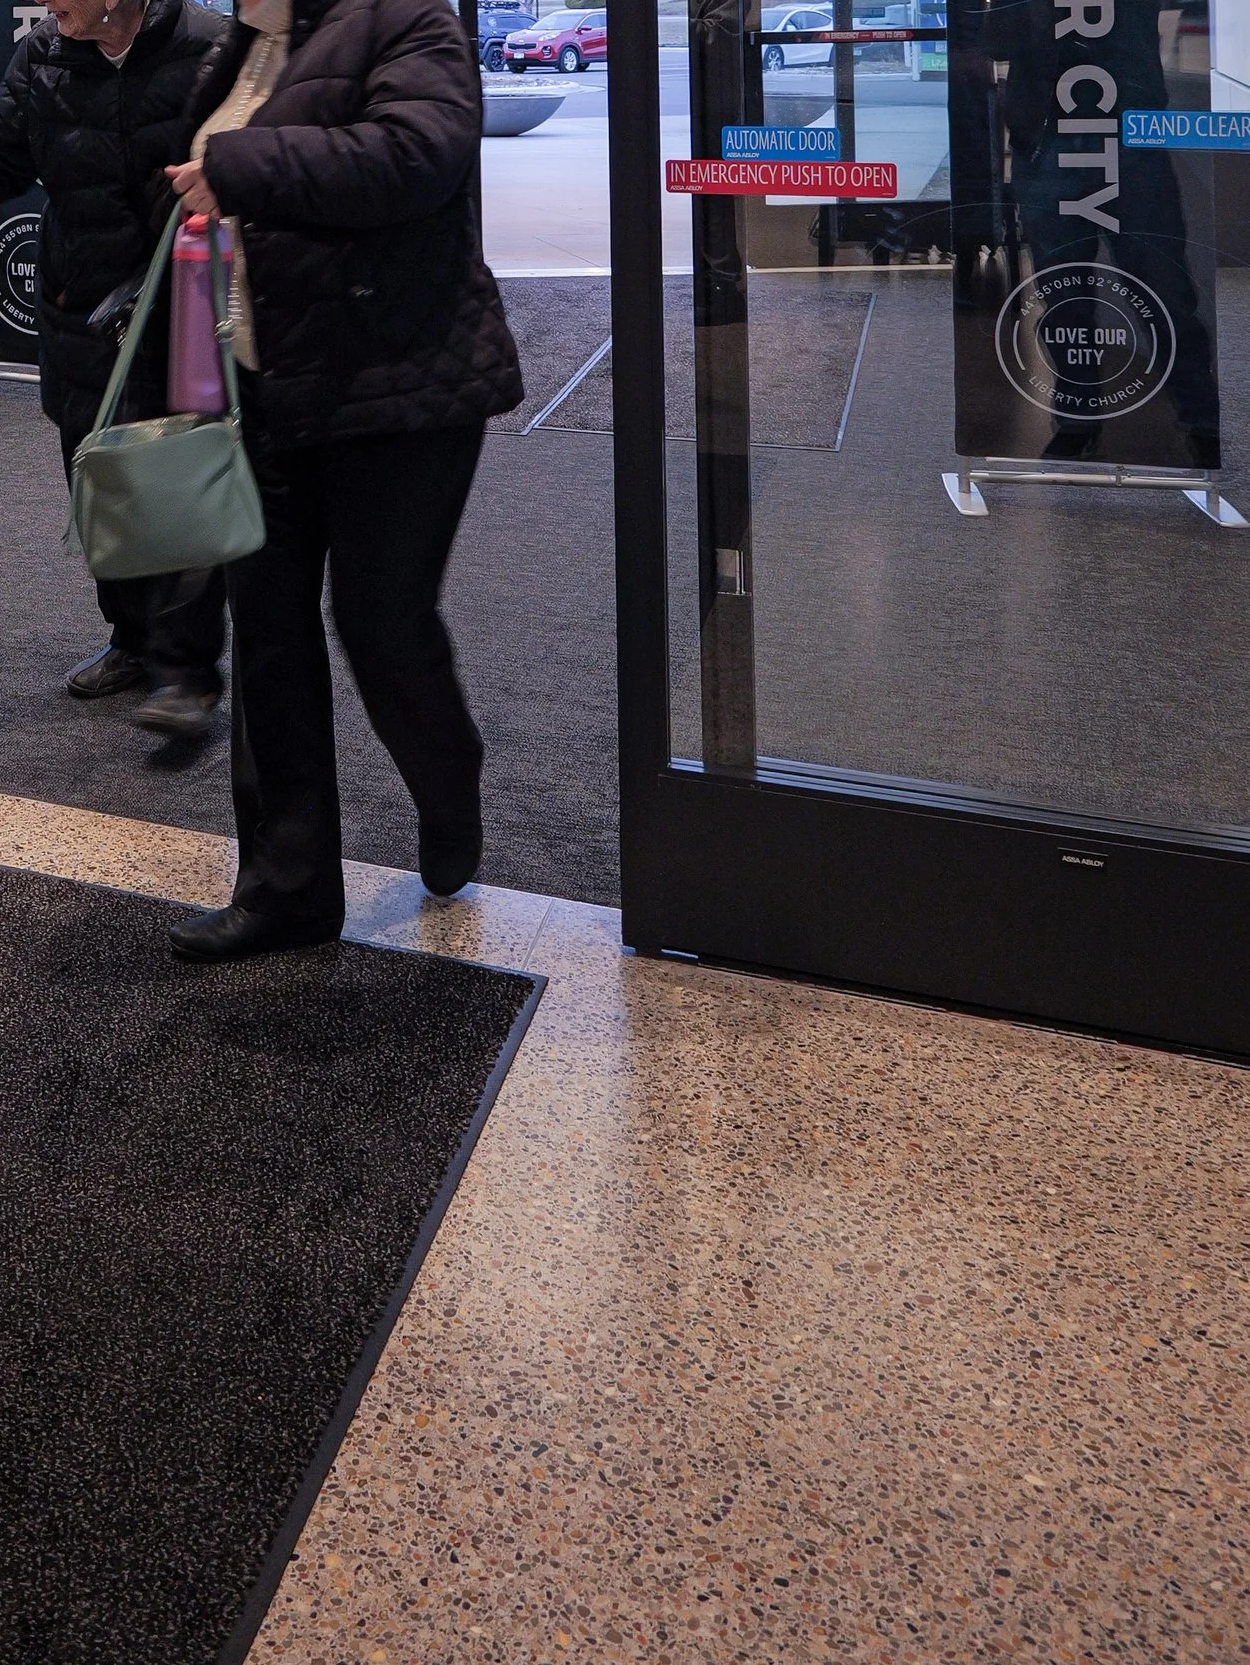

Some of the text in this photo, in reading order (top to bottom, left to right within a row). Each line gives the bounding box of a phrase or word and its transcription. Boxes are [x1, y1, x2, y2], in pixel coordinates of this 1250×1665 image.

[1127, 114, 1250, 138] STAND CLEAR
[725, 130, 837, 152] AUTOMATIC DOOR
[1055, 63, 1120, 234] CITY
[670, 162, 893, 188] IN EMERGENCY PUSH TO OPEN
[11, 262, 36, 277] LOVE
[24, 279, 35, 293] CI
[2, 299, 35, 325] LIBERTY
[1044, 327, 1127, 346] LOVE OUR
[1066, 348, 1104, 366] CITY
[1028, 375, 1145, 408] LIBERTY CHURCH
[1061, 855, 1104, 867] ASSA ABLOY
